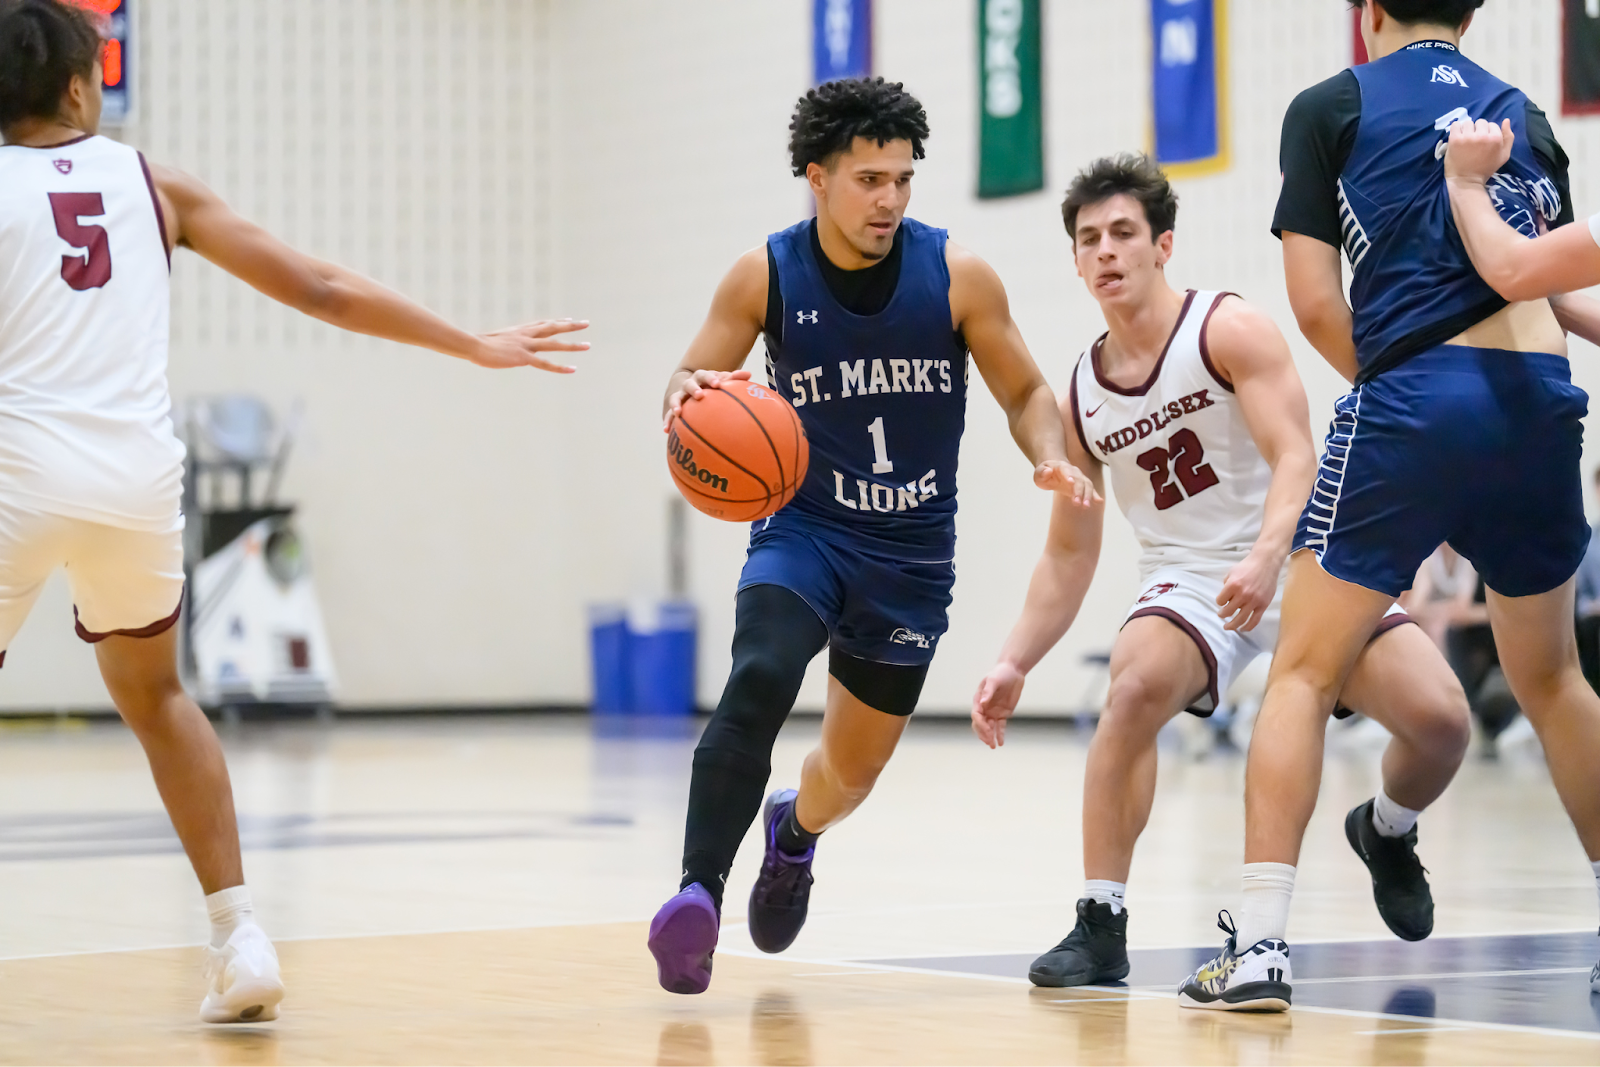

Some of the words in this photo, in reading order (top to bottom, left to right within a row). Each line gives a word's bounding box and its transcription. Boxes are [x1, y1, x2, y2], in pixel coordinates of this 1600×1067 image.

[1406, 41, 1433, 50] NIKE
[1434, 42, 1455, 51] PRO
[47, 192, 112, 291] 5
[790, 365, 832, 408] ST.
[839, 358, 952, 399] MARK'S
[667, 427, 729, 493] Wilson
[867, 416, 894, 475] 1
[1136, 427, 1220, 511] 22
[832, 468, 939, 513] LIONS
